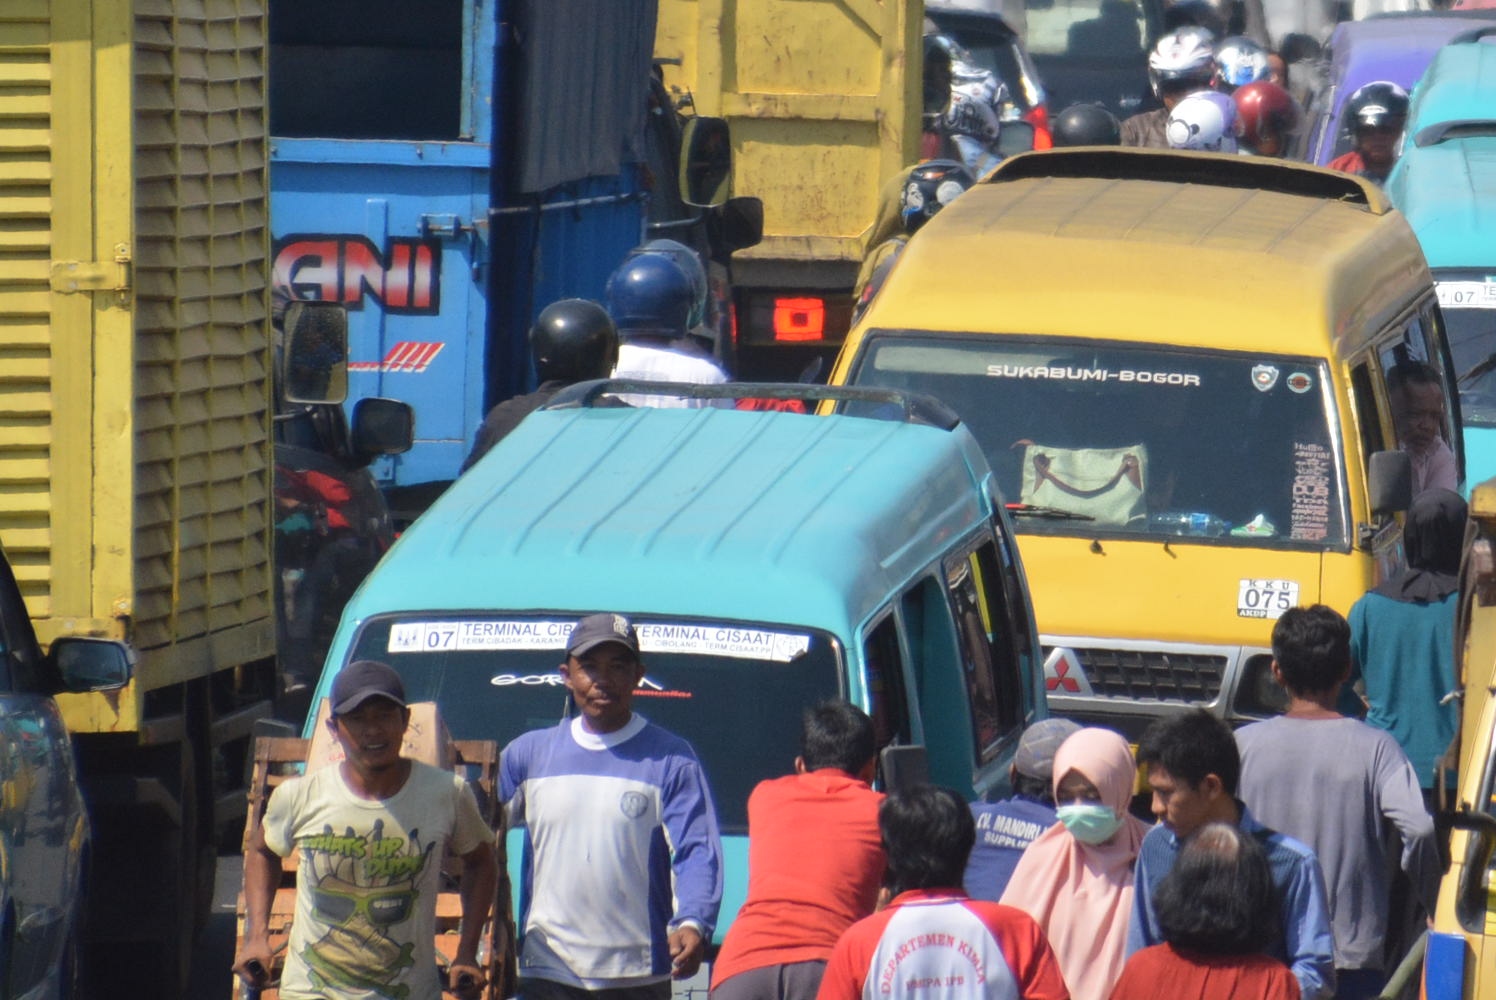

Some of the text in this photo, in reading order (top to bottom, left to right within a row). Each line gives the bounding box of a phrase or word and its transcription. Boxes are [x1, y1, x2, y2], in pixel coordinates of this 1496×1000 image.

[1453, 290, 1476, 304] 07
[986, 364, 1201, 387] SUKABUMI-BOGOR
[1245, 588, 1290, 610] 075
[427, 630, 454, 649] 07
[463, 623, 538, 637] TERMINAL
[715, 628, 774, 647] CISAAT
[993, 815, 1042, 839] MANDIRI
[881, 933, 955, 995] DEPARTEMEN
